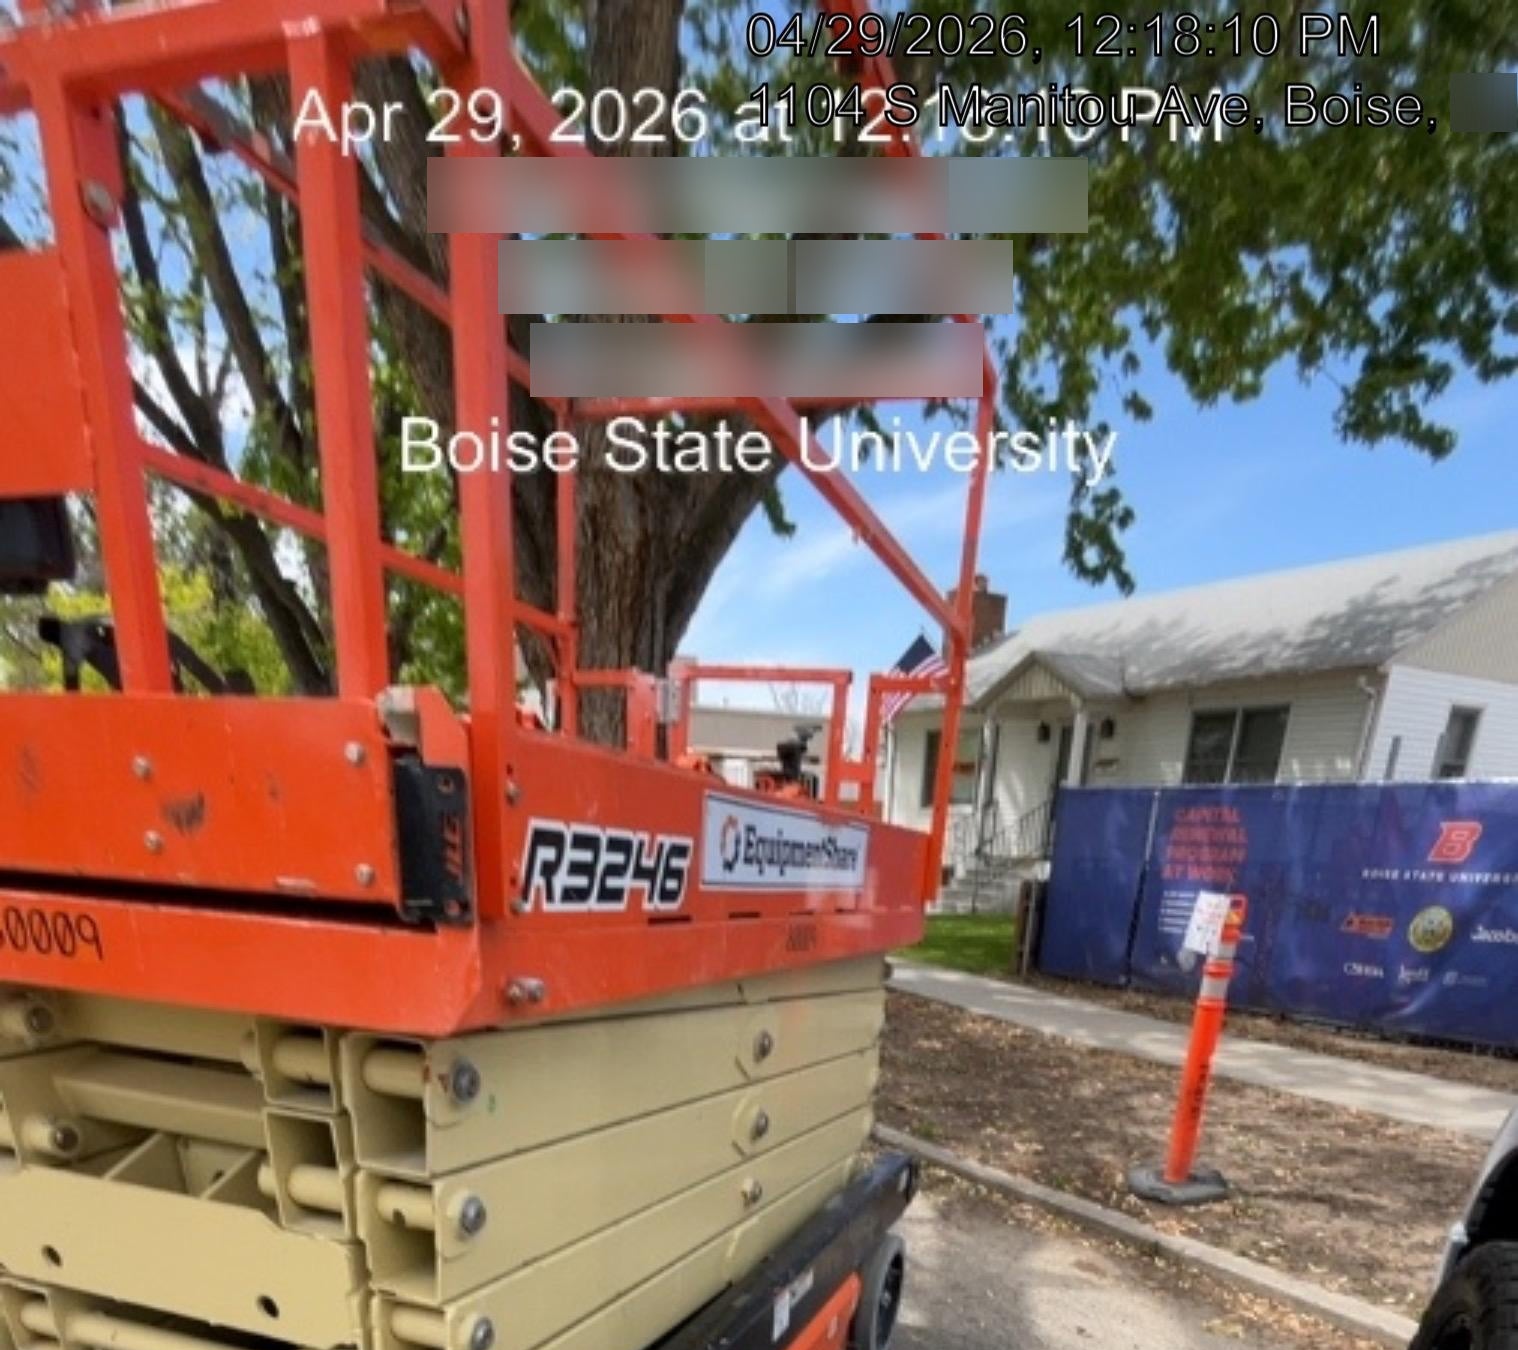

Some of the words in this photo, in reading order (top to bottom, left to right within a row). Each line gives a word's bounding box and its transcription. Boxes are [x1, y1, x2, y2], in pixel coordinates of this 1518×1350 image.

[519, 817, 693, 912] R3246
[742, 824, 859, 876] EquipmentShare
[1427, 821, 1483, 863] B
[0, 904, 104, 961] 0009
